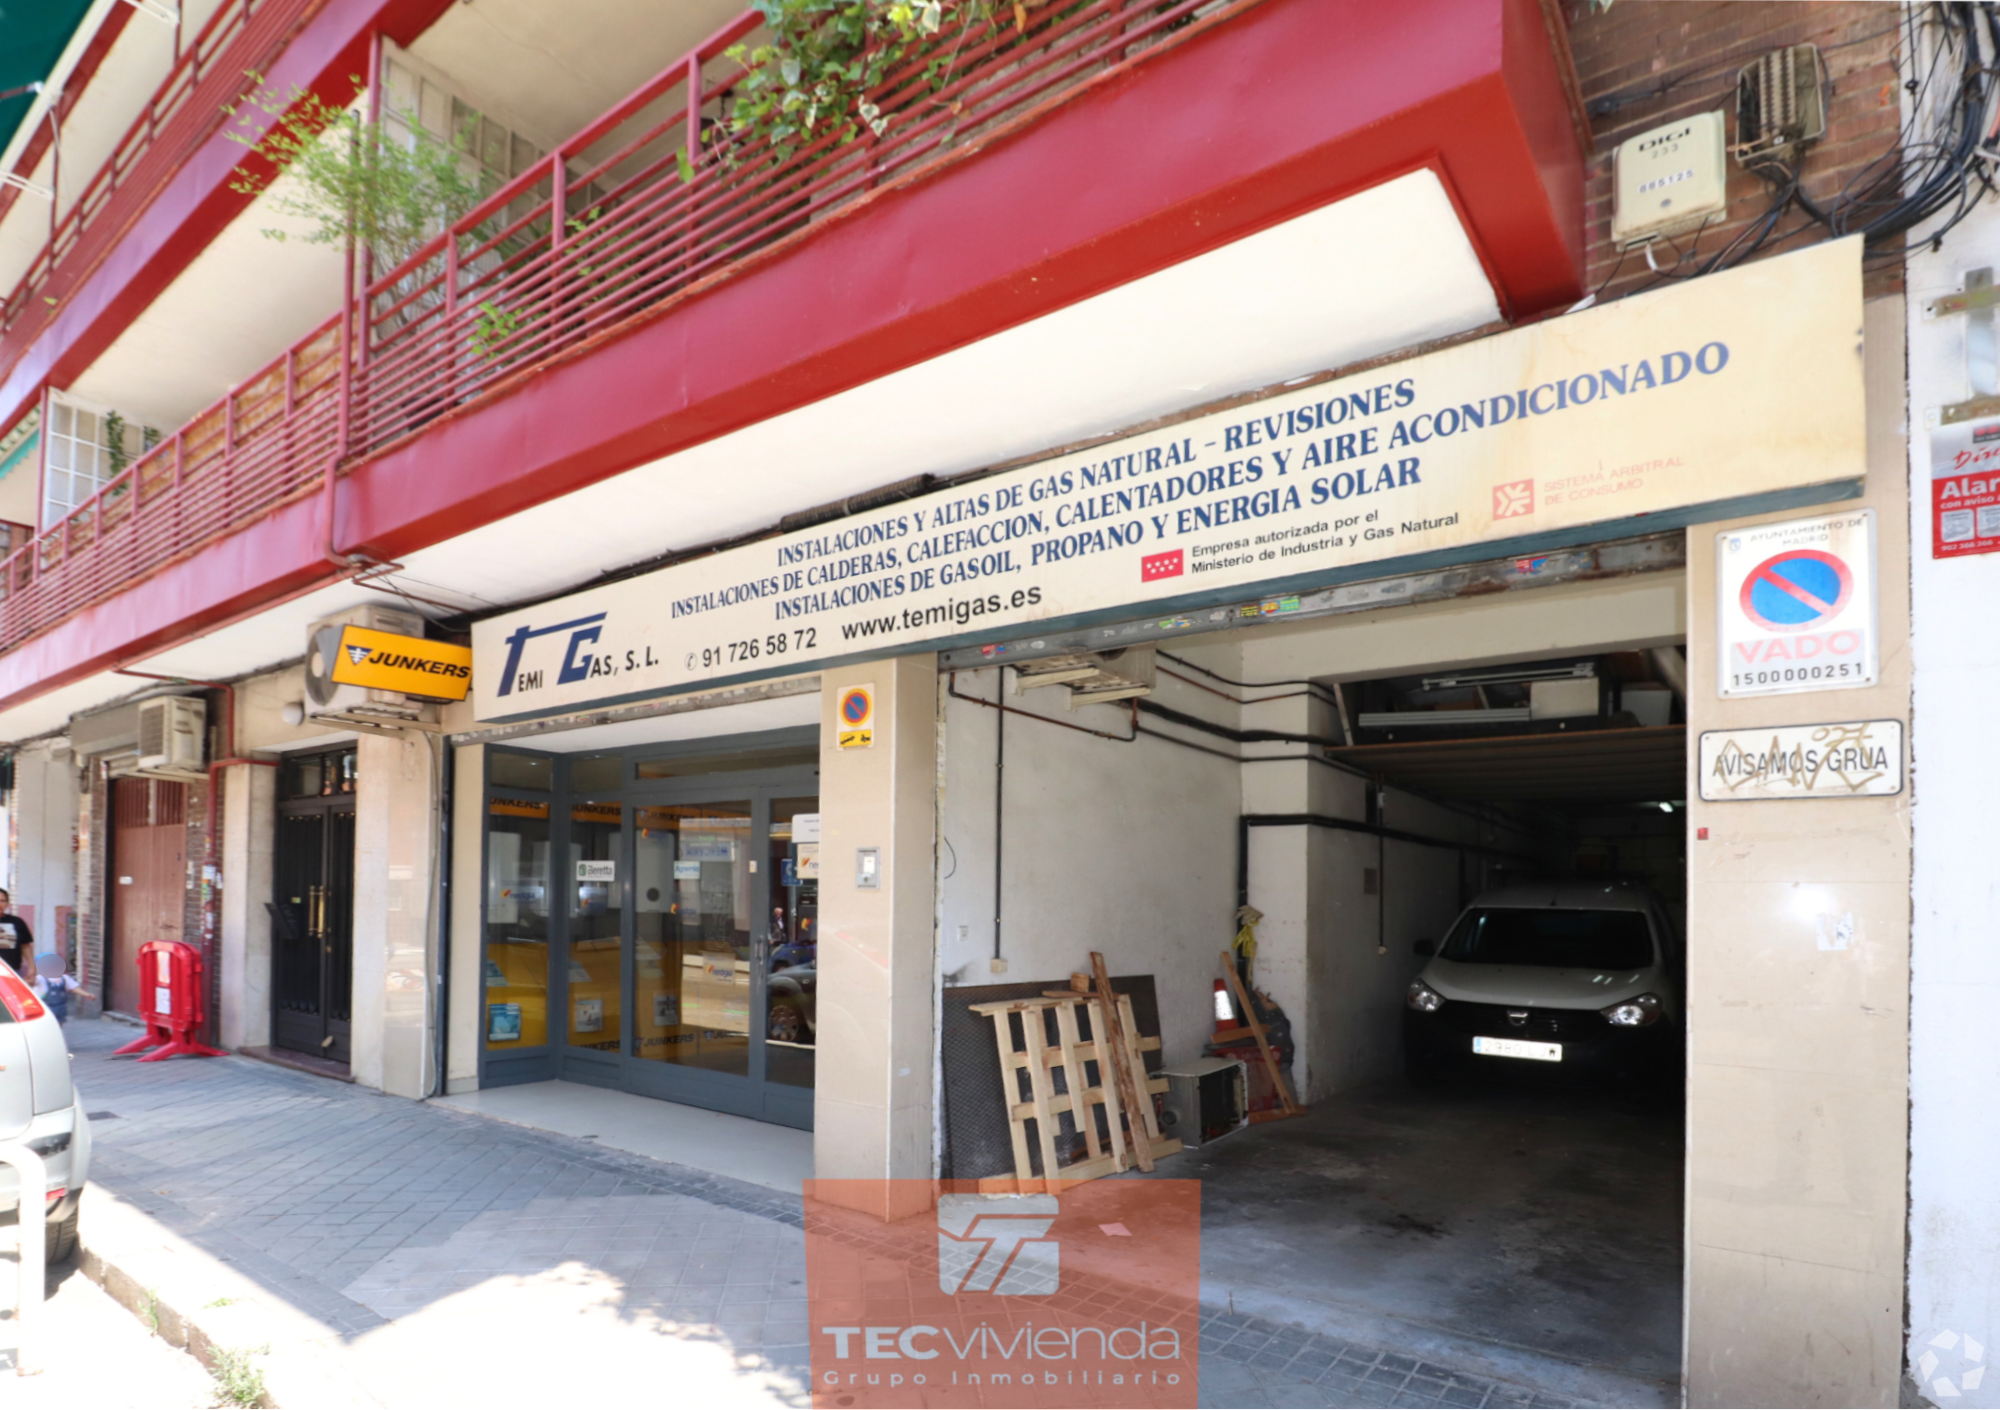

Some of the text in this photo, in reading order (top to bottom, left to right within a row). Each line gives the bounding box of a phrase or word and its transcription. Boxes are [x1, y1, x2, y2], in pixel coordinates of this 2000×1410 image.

[1639, 127, 1690, 152] DIGI
[671, 341, 1730, 619] INSTALACIONES DE CALDERAS, CALEFACCION, CALENTADORES Y AIRE ACONDICIONADO
[778, 516, 908, 567] INSTALACIONES
[912, 511, 927, 531] Y
[932, 495, 989, 528] ALTAS
[995, 486, 1024, 511] DE
[1029, 470, 1074, 500] GAS
[1080, 438, 1196, 491] NATURAL
[1224, 378, 1415, 453] REVISIONES
[1544, 456, 1685, 492] SISTEMA ARBITRAL
[1545, 478, 1643, 506] DE CONSUMO
[775, 456, 1421, 620] INSTALACIONES DE GASOIL, PROPANO Y ENERGIA SOLAR
[1192, 510, 1378, 560] Empresa autorizada por el
[1192, 513, 1458, 574] Ministerio de Industria y Gas Natural
[1750, 518, 1863, 542] AYUNTAMIENTO DE
[1783, 534, 1828, 546] MADRID
[842, 583, 1042, 641] www.temigas.es
[702, 627, 817, 668] 91 726 58 72
[1735, 630, 1860, 664] VADO
[369, 651, 470, 679] JUNKERS
[1733, 662, 1863, 686] 1500000251
[1713, 747, 1888, 777] AVISAMOS GRUA
